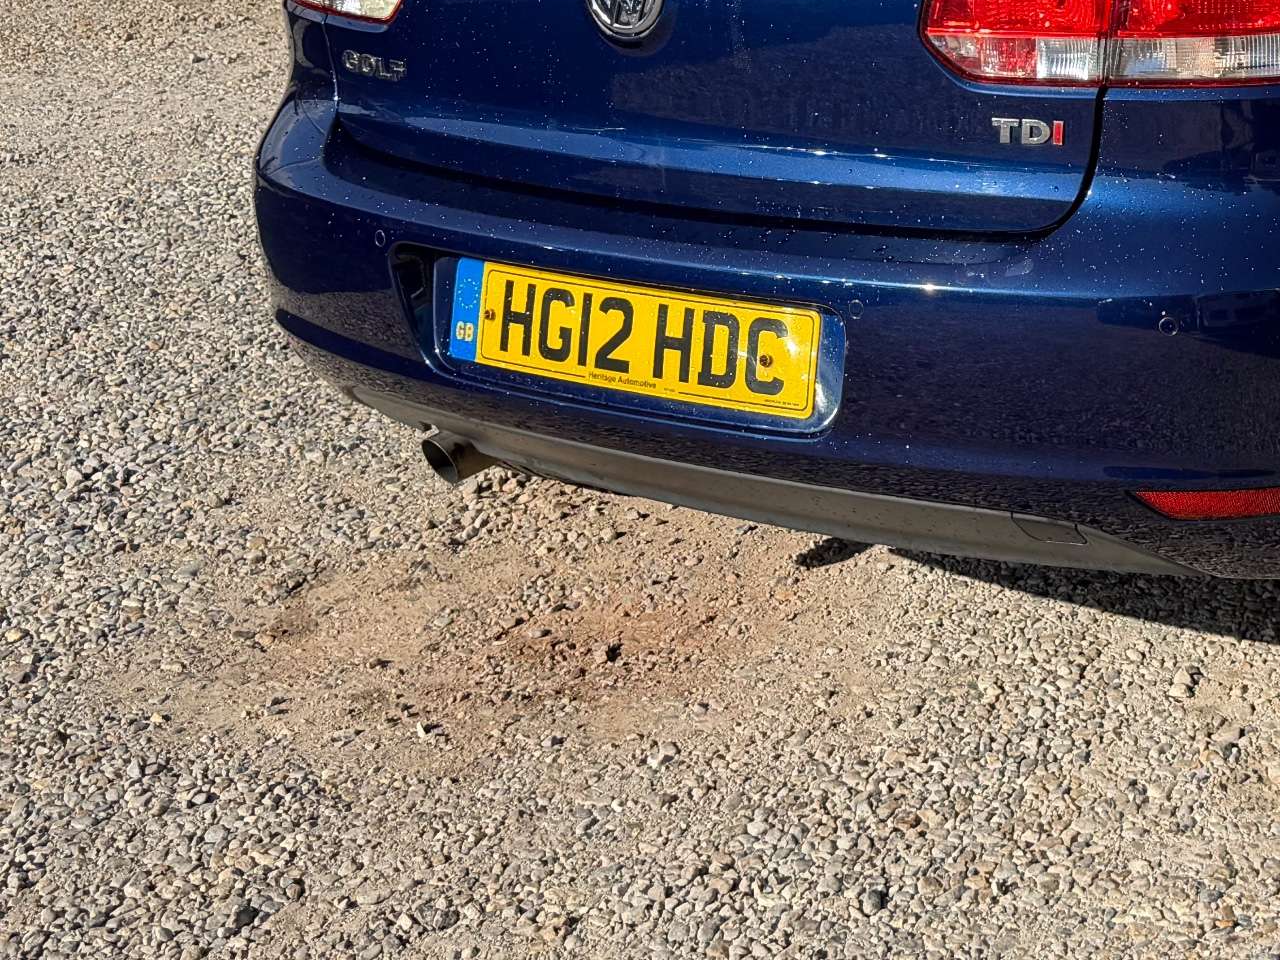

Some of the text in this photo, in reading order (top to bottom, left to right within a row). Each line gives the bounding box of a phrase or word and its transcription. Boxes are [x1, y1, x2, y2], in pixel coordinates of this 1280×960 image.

[343, 50, 408, 81] GOLF
[992, 117, 1065, 146] TDI
[455, 320, 475, 342] GB
[499, 279, 789, 396] HG12 HDC
[588, 371, 657, 389] Heritage Automotive
